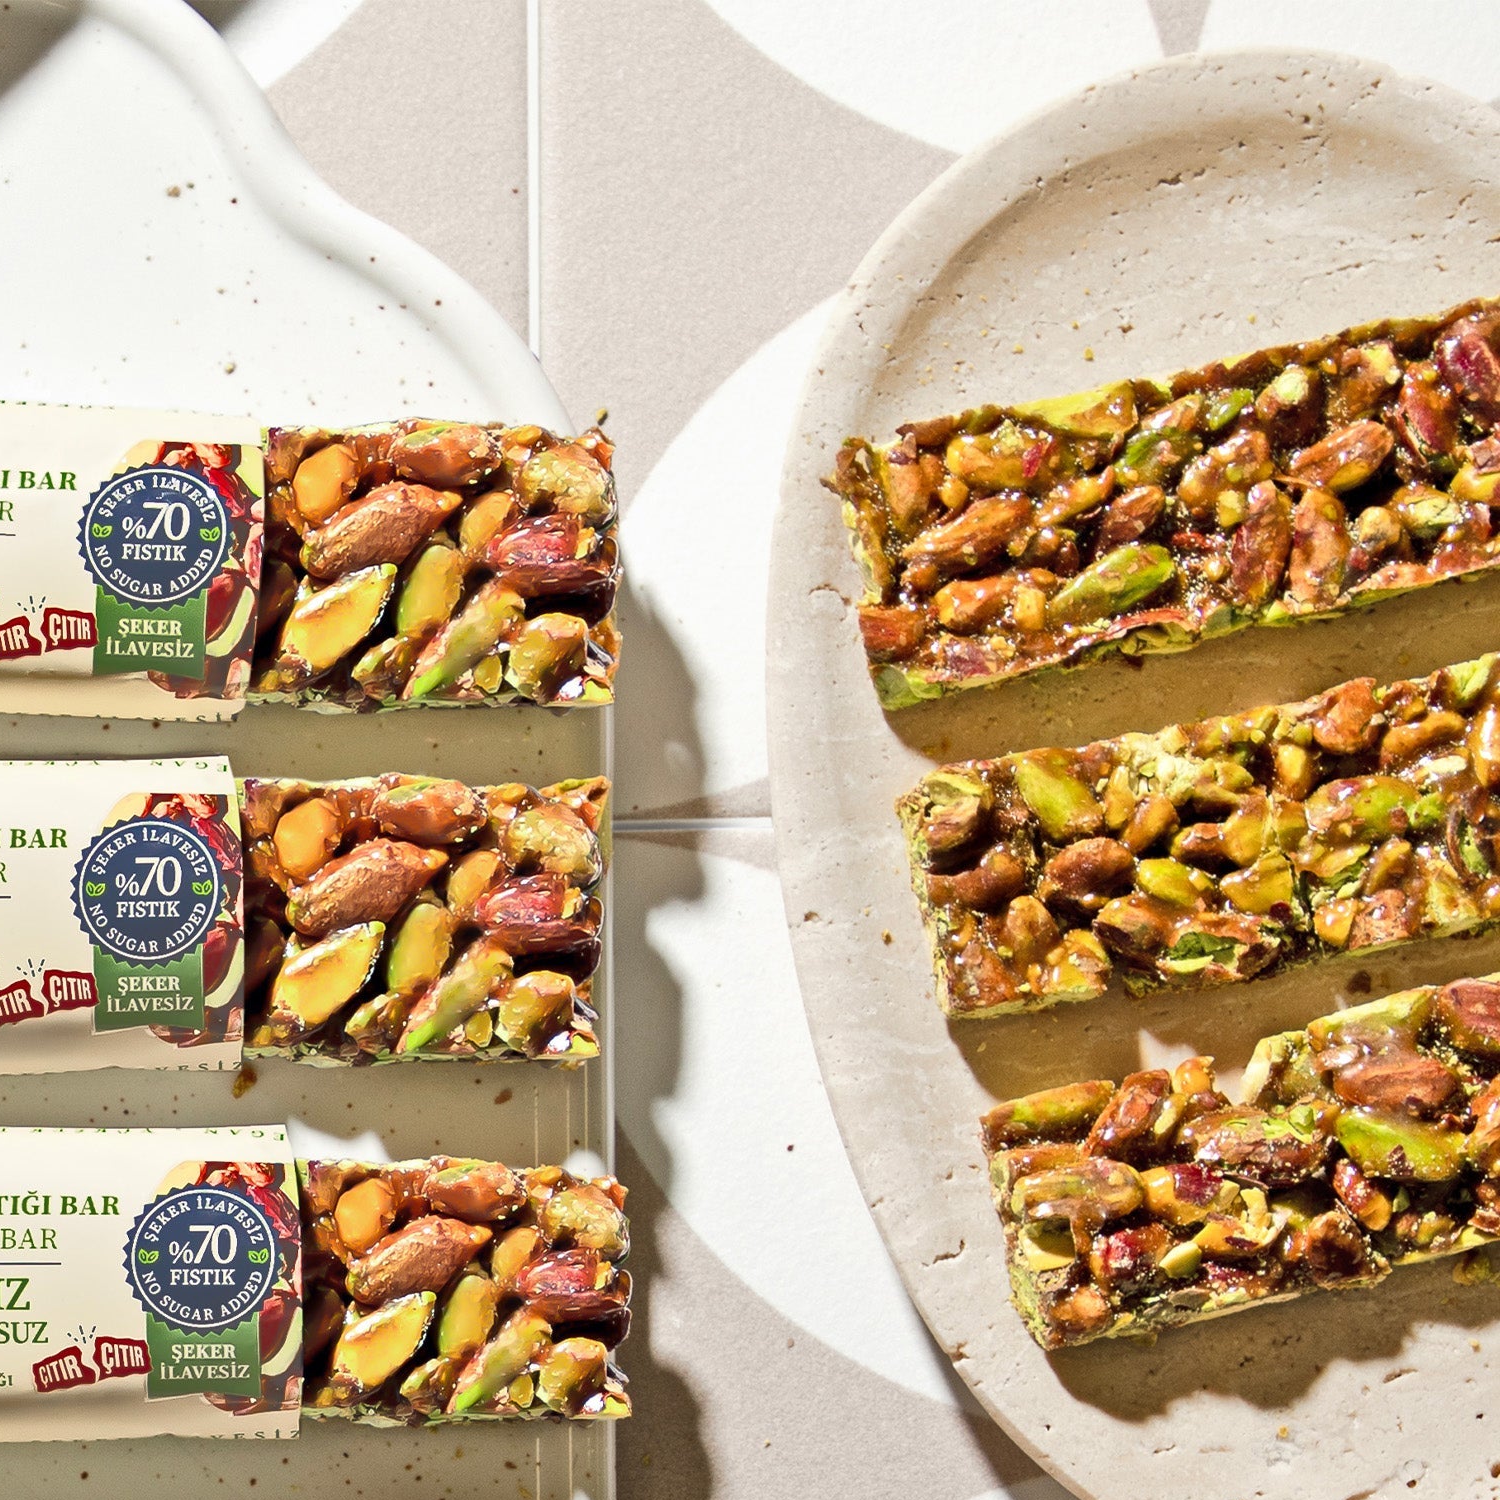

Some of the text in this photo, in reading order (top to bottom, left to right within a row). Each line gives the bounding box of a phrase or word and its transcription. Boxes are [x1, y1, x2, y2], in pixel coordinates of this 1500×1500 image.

[18, 471, 77, 491] BAR
[122, 499, 190, 540] %70
[122, 544, 186, 561] FISTIK
[92, 543, 214, 598] NO SUGAR ADDED
[49, 614, 90, 645] ÇITIR
[118, 618, 182, 638] ŞEKER
[106, 636, 194, 658] İLAVESİZ
[10, 828, 67, 848] BAR
[116, 856, 182, 896] %70
[117, 901, 180, 917] FISTIK
[88, 902, 207, 954] NO SUGAR ADDED
[50, 976, 91, 1007] ÇITIR
[118, 976, 180, 996] ŞEKER
[107, 994, 193, 1012] İLAVESİZ
[60, 1196, 120, 1215] BAR
[0, 1228, 57, 1249] BAR
[169, 1225, 237, 1264] %70
[170, 1269, 235, 1285] FISTIK
[141, 1269, 263, 1322] NO SUGAR ADDED
[172, 1344, 236, 1364] ŞEKER
[39, 1343, 144, 1387] ÇITIR ÇITIR
[161, 1362, 250, 1379] İLAVESİZ
